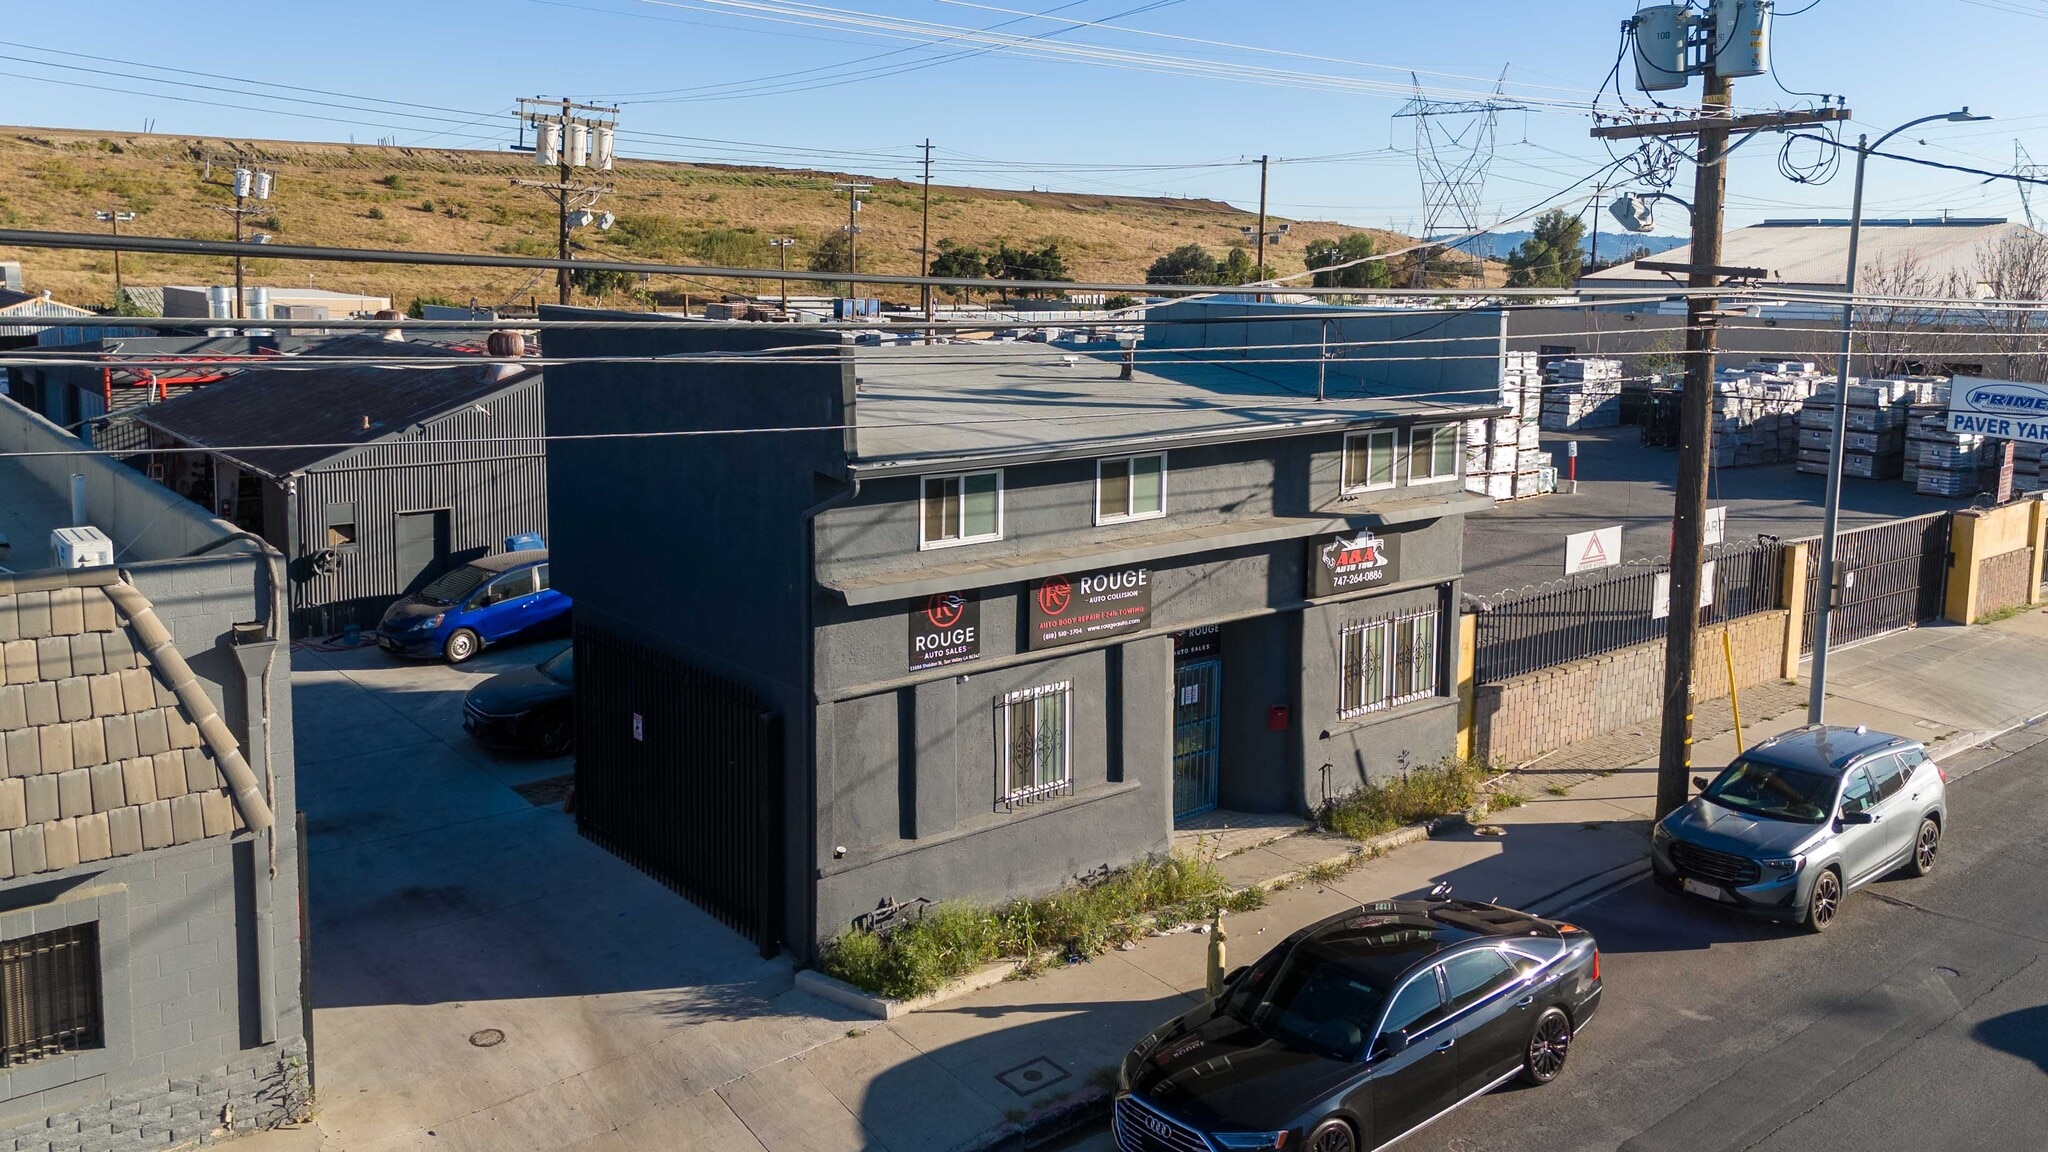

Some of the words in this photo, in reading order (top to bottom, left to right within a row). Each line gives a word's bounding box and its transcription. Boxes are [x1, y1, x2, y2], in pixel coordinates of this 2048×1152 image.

[1656, 31, 1670, 40] 100
[1752, 58, 1760, 66] 50
[1971, 391, 2048, 410] PRIME
[1953, 414, 2011, 436] PAVER
[1335, 564, 1356, 573] AUTO
[1357, 561, 1375, 570] TOW
[1080, 568, 1147, 595] ROUGE
[1333, 570, 1383, 587] 747-264-0886
[1089, 595, 1106, 603] AUTO
[1107, 590, 1138, 600] COLLISION
[1039, 620, 1057, 629] AUTO
[1058, 617, 1076, 626] BODY
[1078, 614, 1100, 623] REPAIR
[1119, 606, 1145, 616] TOWING
[1188, 624, 1220, 637] ROUGE
[915, 627, 975, 652] ROUGE
[924, 650, 944, 660] AUTO
[945, 645, 967, 655] SALES
[1191, 643, 1210, 653] SALES
